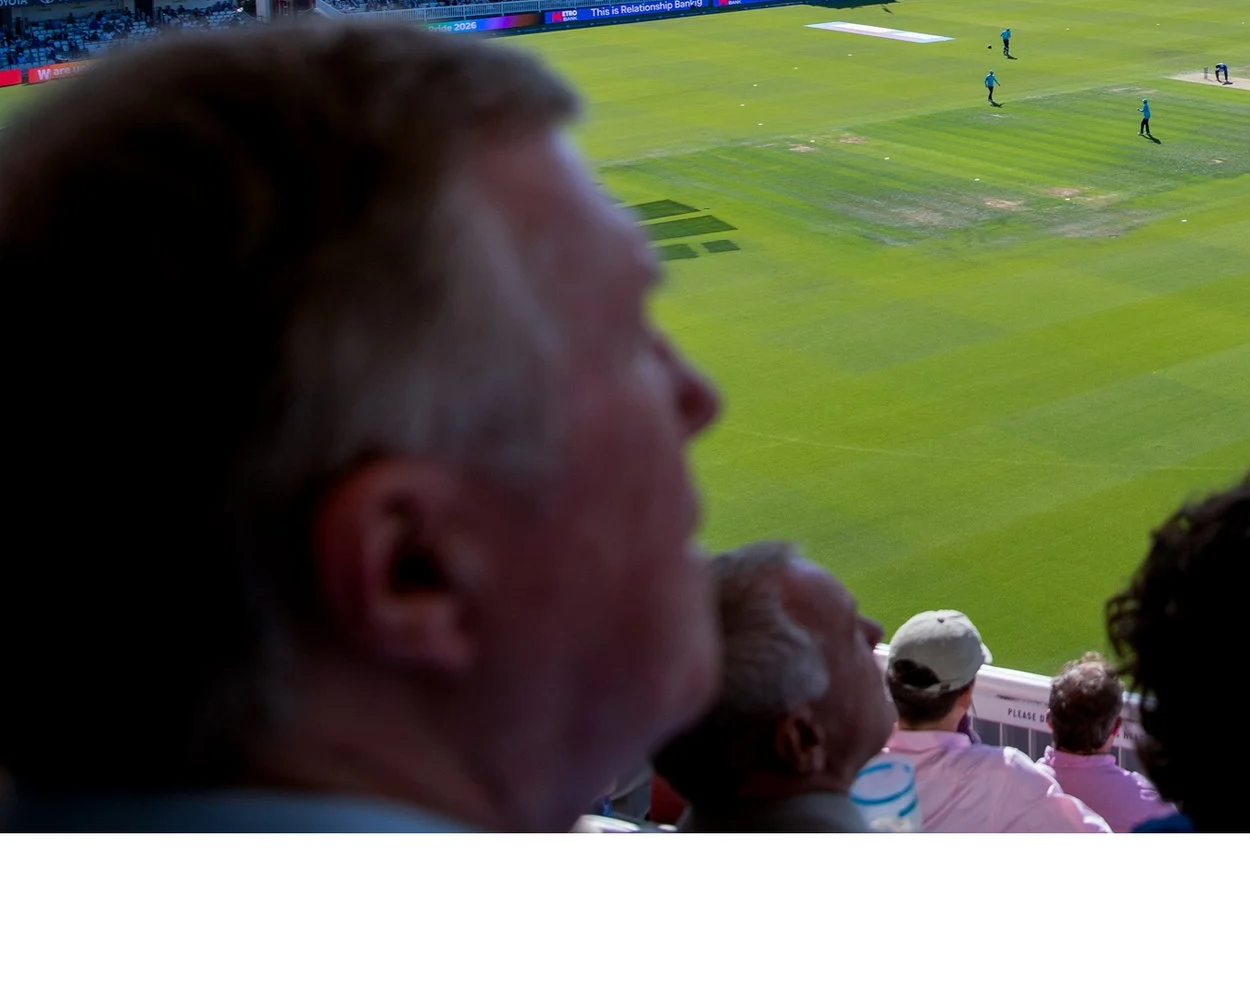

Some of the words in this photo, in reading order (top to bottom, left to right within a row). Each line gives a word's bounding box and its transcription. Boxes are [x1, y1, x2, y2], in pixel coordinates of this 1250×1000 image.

[591, 8, 610, 17] This
[612, 6, 619, 15] is
[621, 1, 673, 14] Relationship
[552, 10, 577, 22] METRO
[454, 22, 477, 31] 2026
[53, 67, 70, 76] are
[1008, 708, 1036, 721] PLEASE
